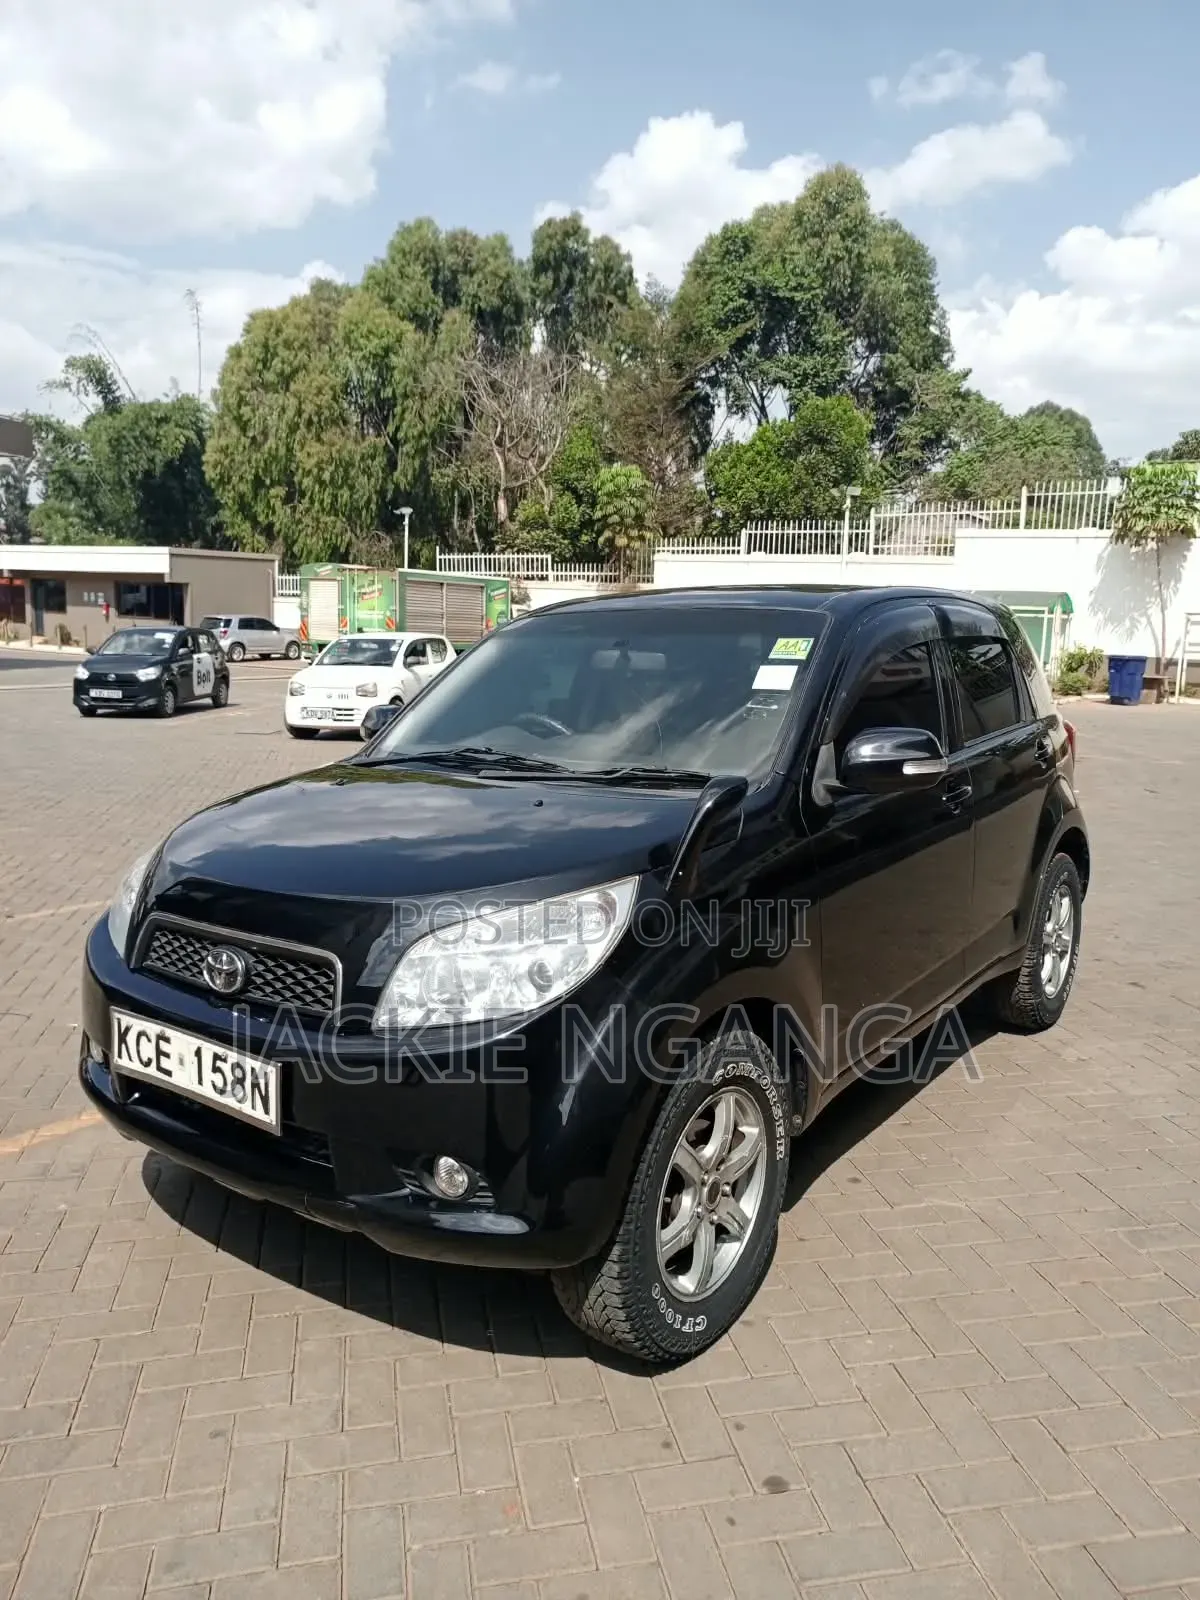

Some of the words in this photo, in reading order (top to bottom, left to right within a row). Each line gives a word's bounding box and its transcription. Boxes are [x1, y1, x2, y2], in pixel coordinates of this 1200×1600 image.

[197, 670, 211, 687] Bolt
[116, 1017, 172, 1078] KCE
[194, 1046, 270, 1116] 158N
[712, 1062, 786, 1161] COMFORSER
